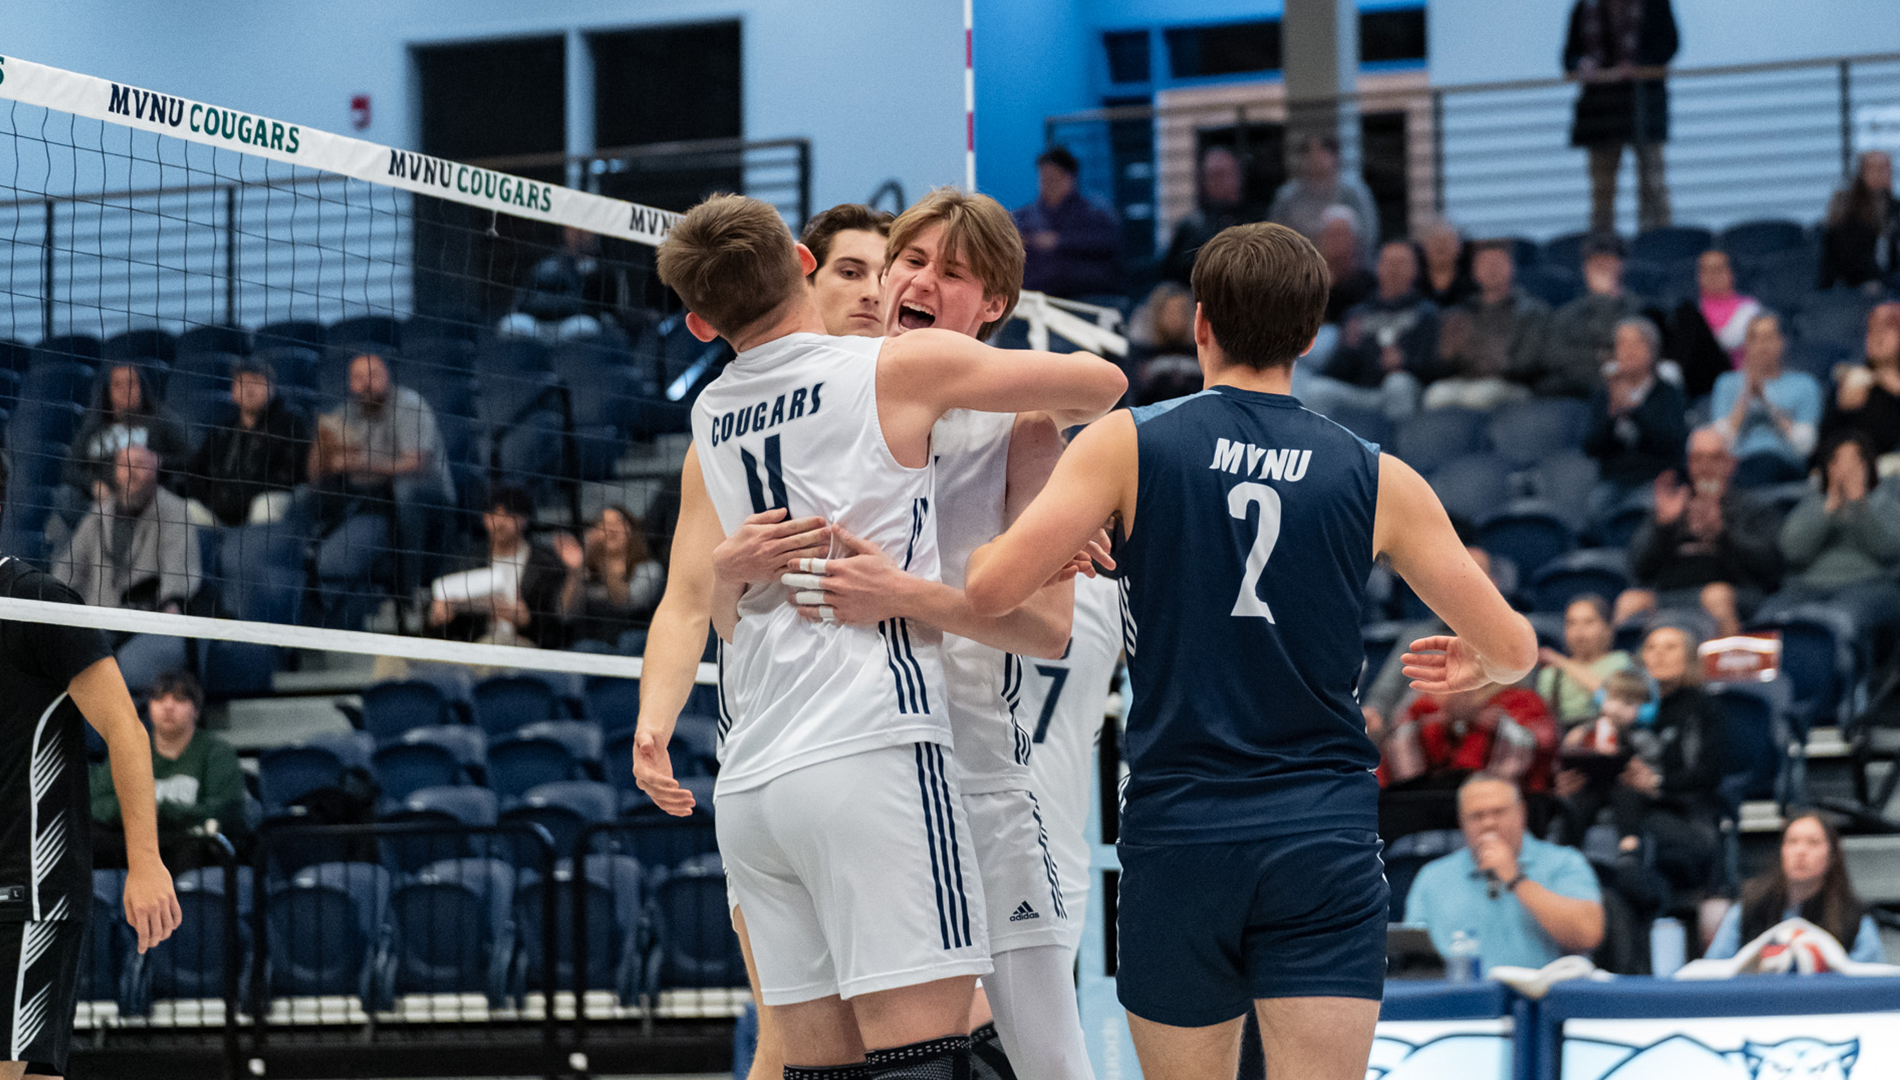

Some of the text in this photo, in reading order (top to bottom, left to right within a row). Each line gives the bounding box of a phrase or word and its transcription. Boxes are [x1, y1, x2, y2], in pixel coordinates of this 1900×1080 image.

[109, 83, 299, 153] MVNU COUGARS
[388, 149, 552, 212] MVNU COUGARS
[629, 206, 679, 237] MVN
[711, 382, 826, 447] COUGARS
[1209, 437, 1312, 482] MVNU
[1227, 481, 1281, 624] 2
[1032, 664, 1070, 744] 7
[1009, 911, 1040, 921] adidas
